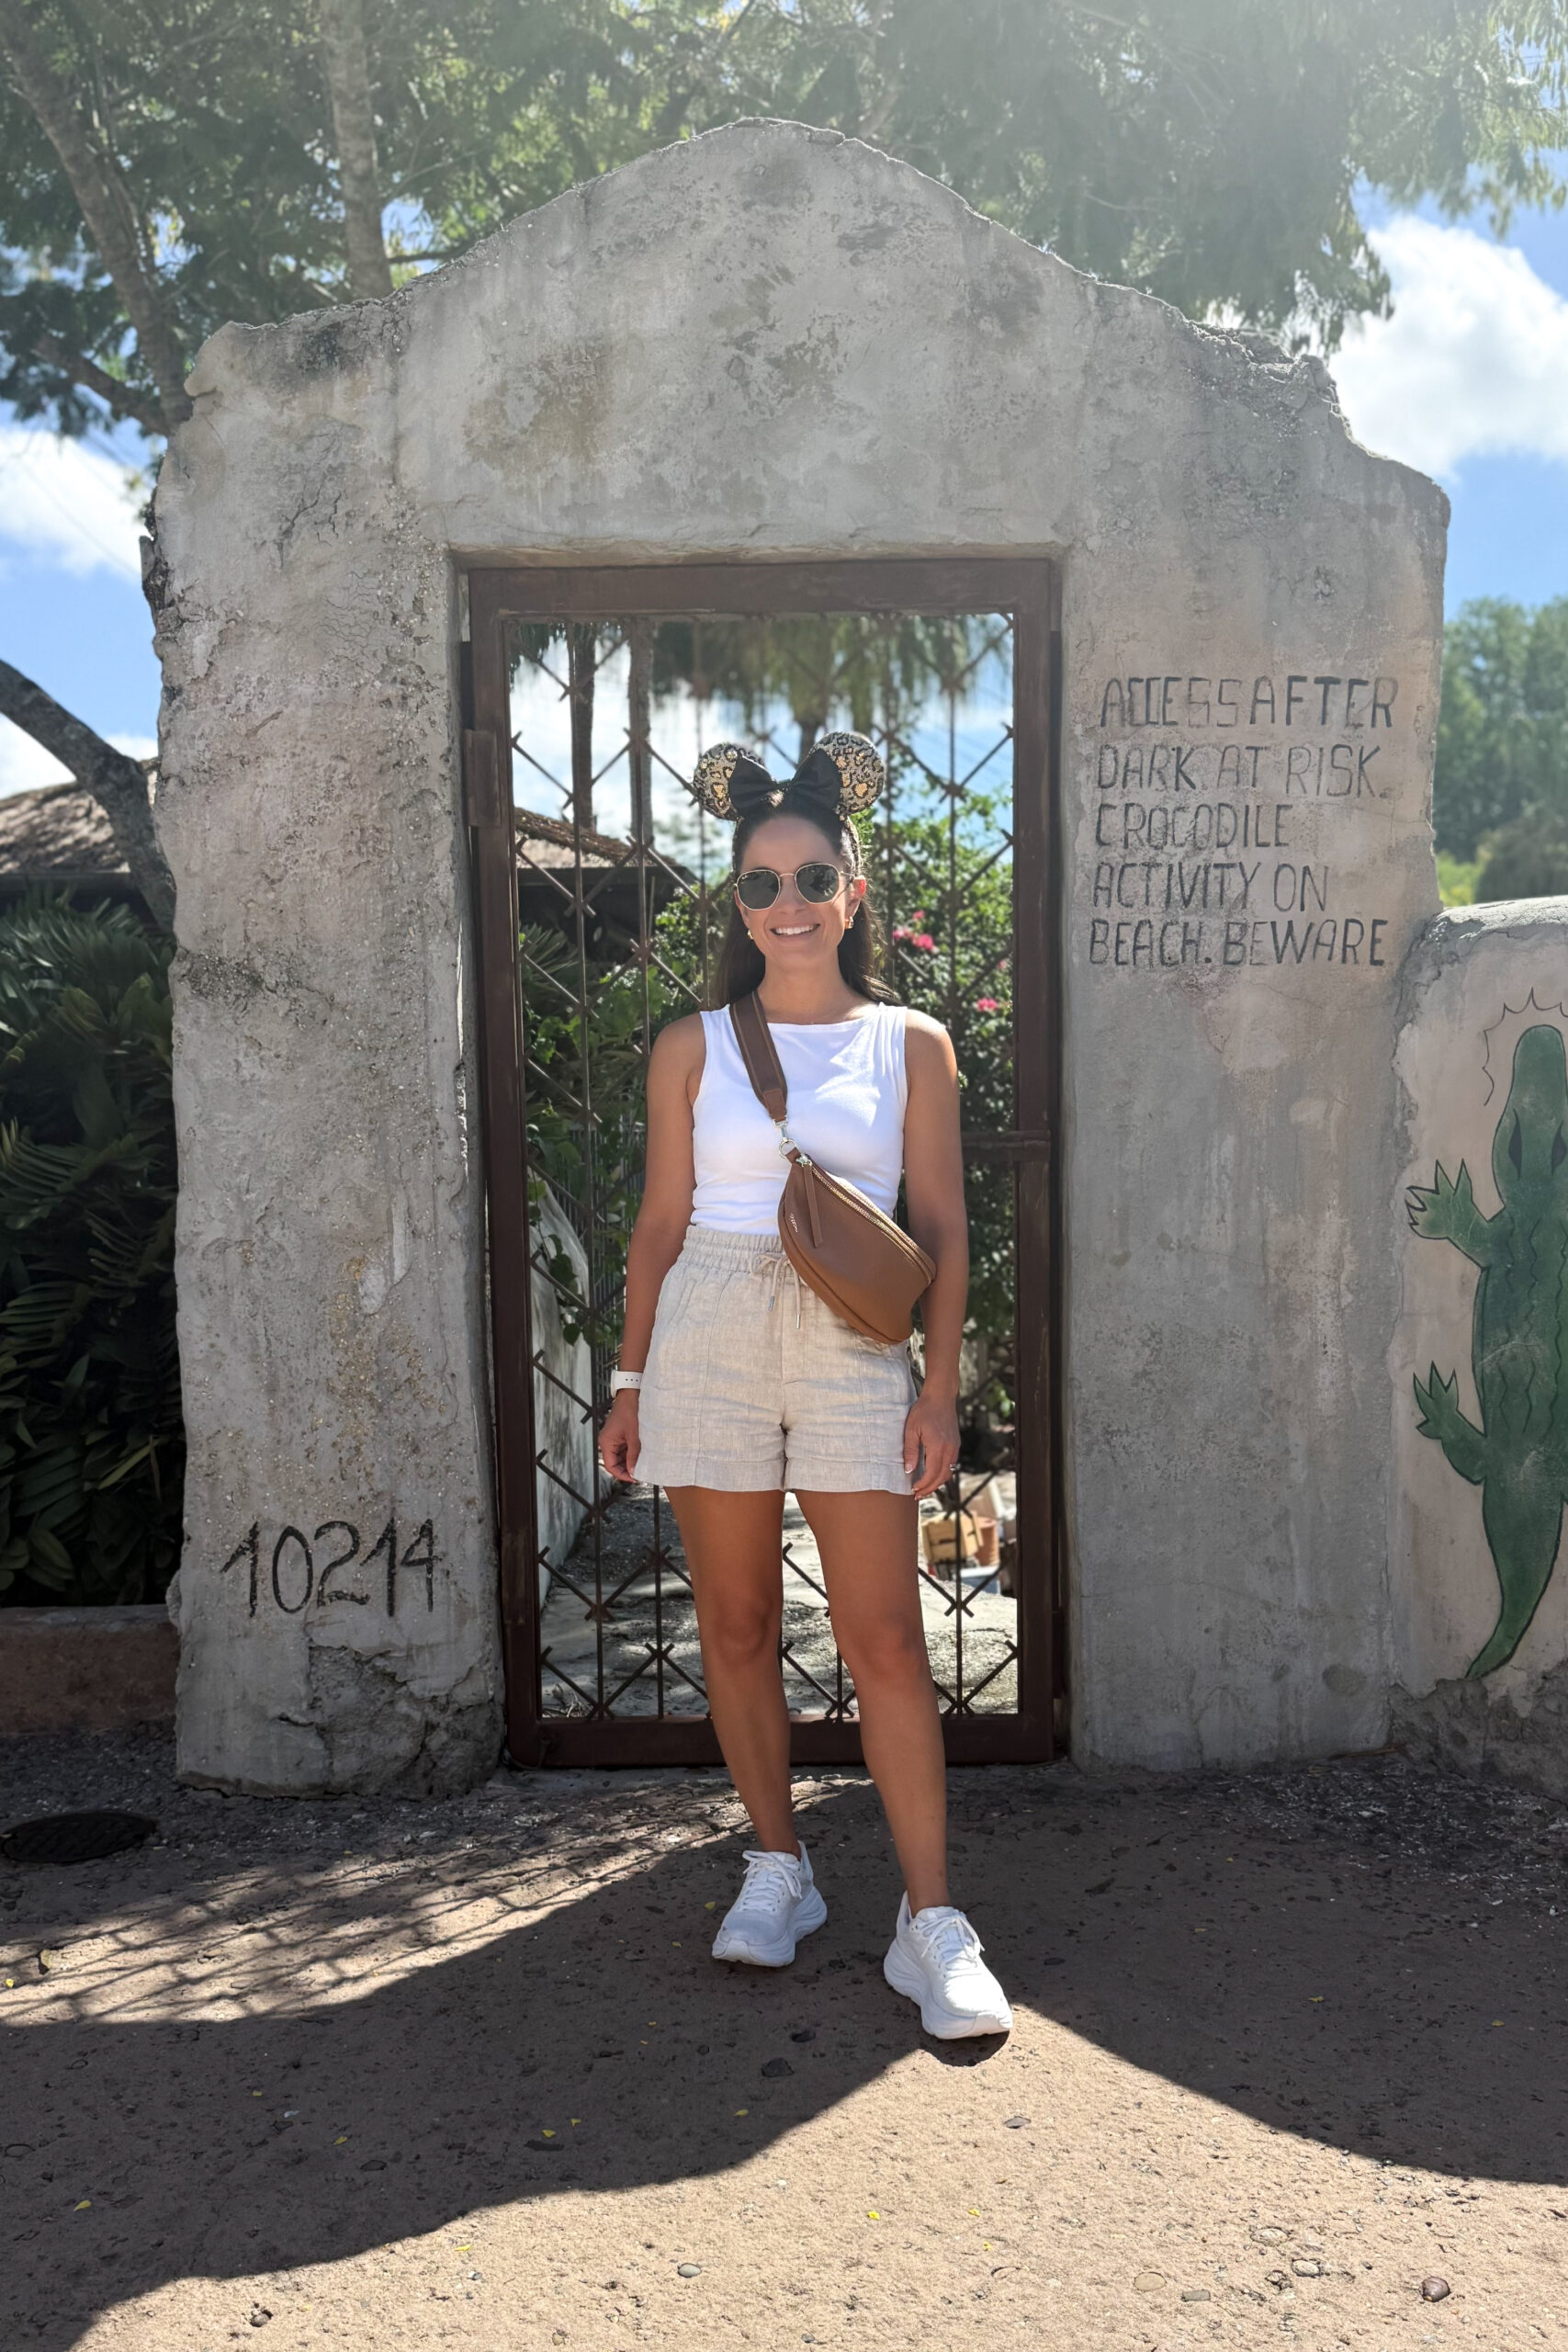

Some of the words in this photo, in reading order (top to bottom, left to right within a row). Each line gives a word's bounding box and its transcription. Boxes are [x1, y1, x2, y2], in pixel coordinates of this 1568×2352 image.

[1249, 675, 1399, 729] AFTER
[1098, 744, 1196, 791] DARK
[1217, 744, 1269, 788] AT
[1096, 802, 1293, 850] CROCODILE
[1093, 862, 1260, 910] ACTIVITY
[1274, 864, 1329, 912] ON
[1223, 919, 1388, 967] BEWARE
[220, 1510, 442, 1617] 10214
